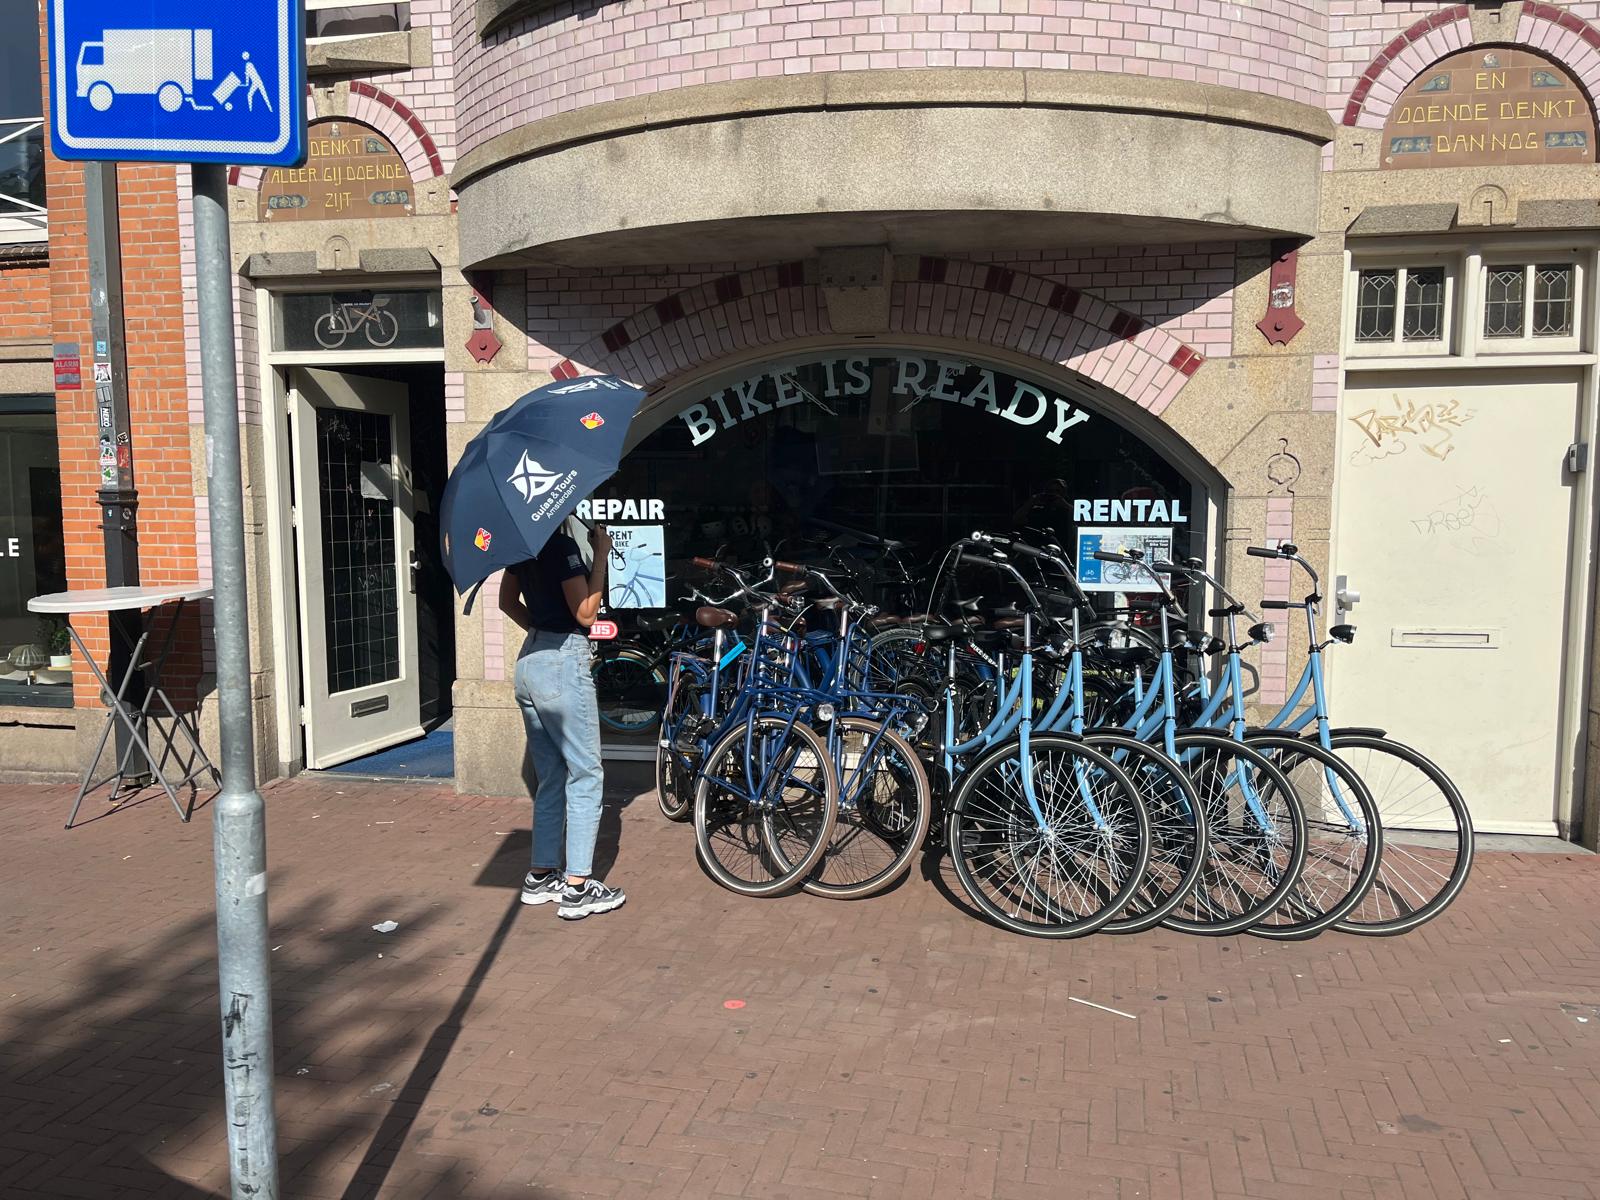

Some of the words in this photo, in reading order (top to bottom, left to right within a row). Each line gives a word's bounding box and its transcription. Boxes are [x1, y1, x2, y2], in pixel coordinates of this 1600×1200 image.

[1475, 72, 1505, 90] EN
[1396, 103, 1489, 124] DOENDE
[1499, 99, 1576, 120] DENKT
[310, 138, 362, 156] DENKT
[1437, 134, 1485, 153] DAN
[1491, 132, 1538, 151] NOG
[271, 167, 317, 184] ALEER
[323, 167, 343, 186] GIJ
[346, 164, 406, 181] DOENDE
[324, 192, 352, 212] ZIJT
[678, 364, 804, 447] BIKE
[821, 356, 871, 397] IS
[892, 356, 1091, 445] READY
[554, 470, 578, 492] Tours
[546, 484, 577, 519] Amsterdam
[575, 498, 665, 520] REPAIR
[1073, 499, 1187, 522] RENTAL
[609, 531, 633, 540] RENT
[0, 538, 20, 557] E
